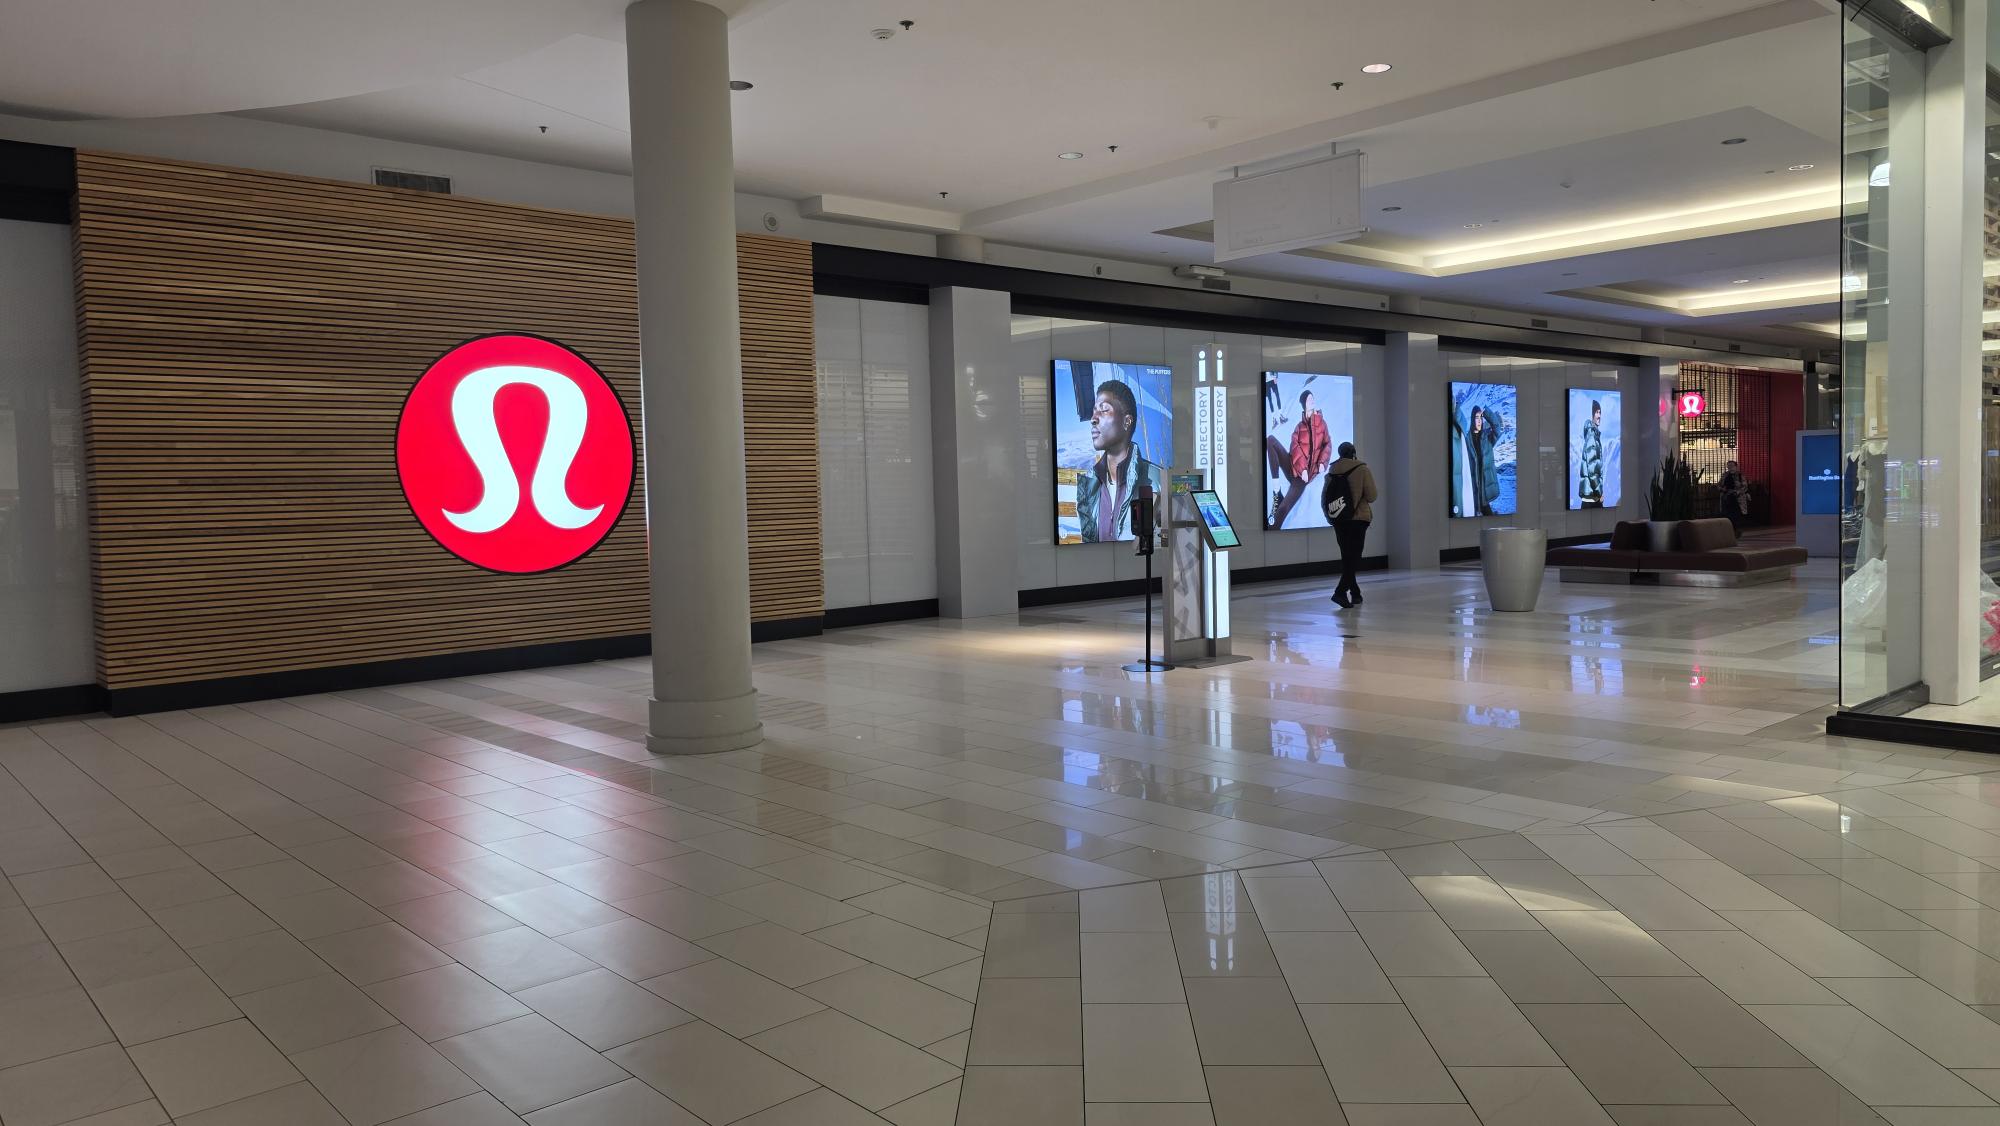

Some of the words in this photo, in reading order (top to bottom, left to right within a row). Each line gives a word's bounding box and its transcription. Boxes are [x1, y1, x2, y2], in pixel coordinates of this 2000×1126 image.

[1199, 391, 1208, 465] DIRECTORY
[1216, 390, 1224, 465] DIRECTORY
[1328, 496, 1345, 513] NIKE
